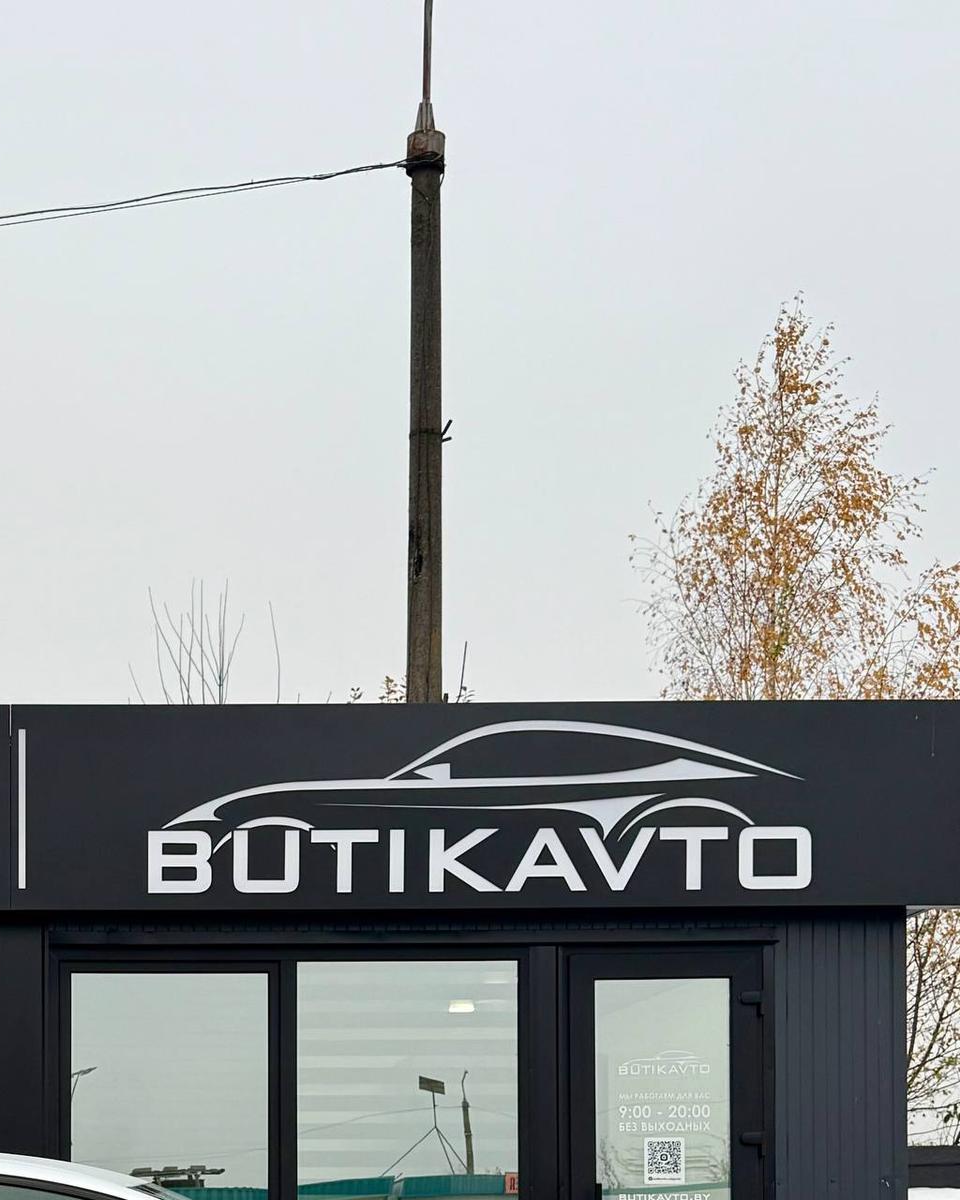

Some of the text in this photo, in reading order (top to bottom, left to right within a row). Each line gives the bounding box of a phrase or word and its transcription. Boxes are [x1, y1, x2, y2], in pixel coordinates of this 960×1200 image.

[146, 825, 813, 895] BUTIKAVTO
[618, 1064, 710, 1075] BUTIKAVTO
[618, 1105, 652, 1119] 9:00
[668, 1104, 711, 1118] 20:00
[619, 1121, 711, 1132] БЕЗ ВЫХОДНЫХ
